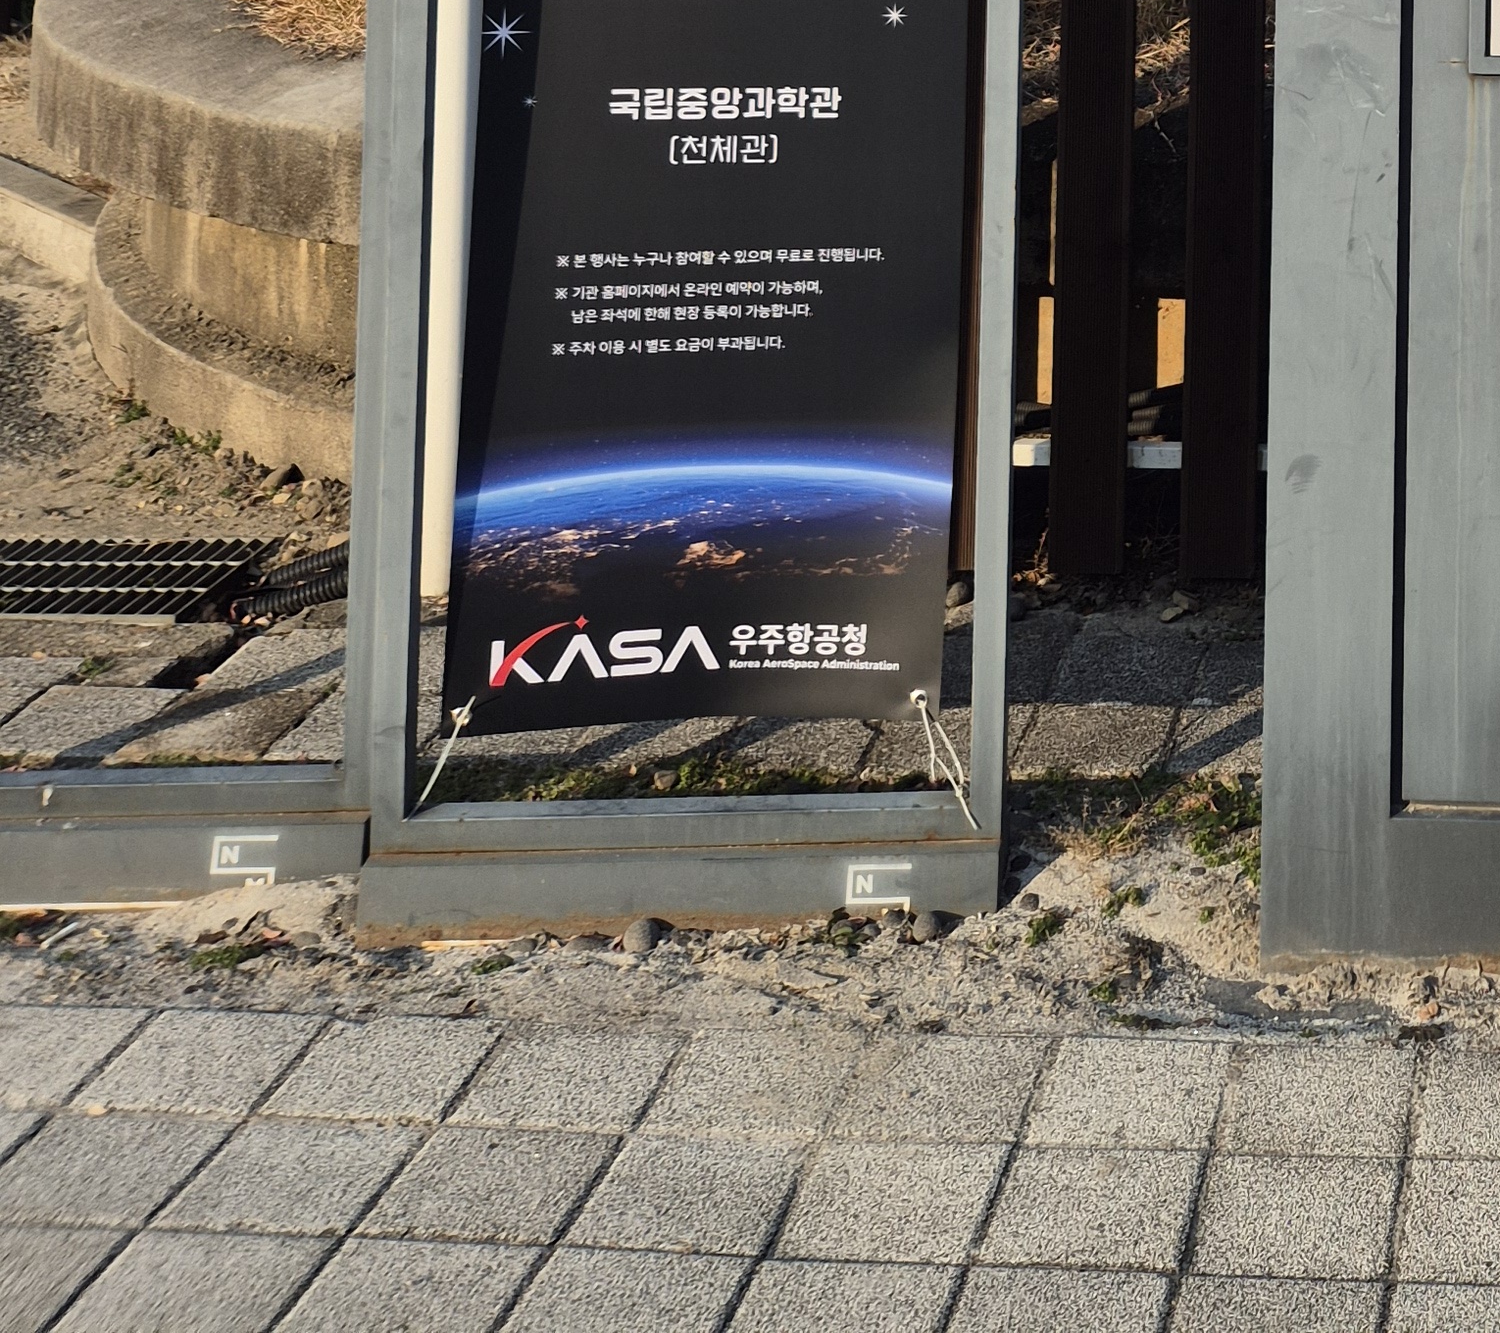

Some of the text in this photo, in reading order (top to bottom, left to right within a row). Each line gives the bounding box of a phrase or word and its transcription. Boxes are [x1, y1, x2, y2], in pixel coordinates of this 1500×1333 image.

[608, 86, 842, 121] 국립중앙과학관
[573, 247, 885, 268] 본 행사는 누구나 참여할 수 있으며 무료로 진행됩니다.
[572, 280, 823, 300] 기관 홈페이지에서 온라인 예약이 가능하며,
[571, 303, 813, 324] 남은 좌석에 한해 현장 등록이 가능합니다.
[569, 336, 785, 356] 주차 이용 시 별도 요금이 부과됩니다.
[728, 622, 868, 657] 우주항공청
[488, 619, 720, 687] KASA
[729, 659, 900, 671] Korea AeroSpace Administration
[220, 845, 240, 864] N
[856, 874, 873, 893] N
